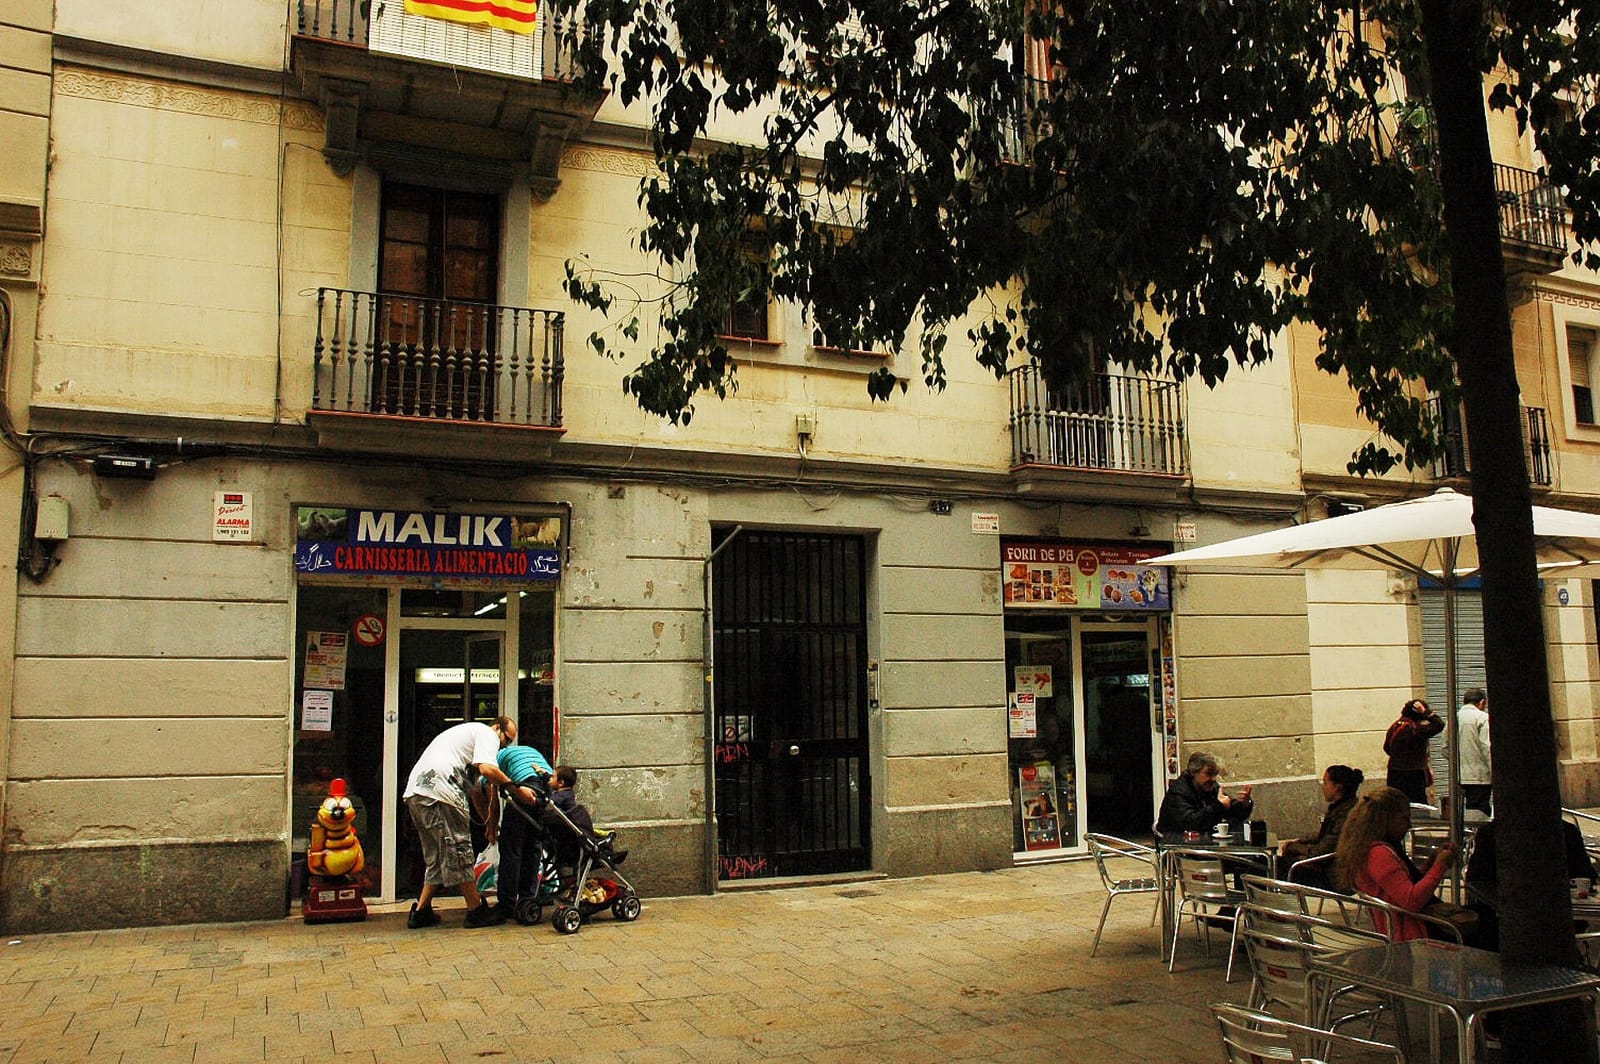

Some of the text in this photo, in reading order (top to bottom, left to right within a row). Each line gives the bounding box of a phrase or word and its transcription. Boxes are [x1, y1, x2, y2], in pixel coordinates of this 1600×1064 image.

[216, 518, 249, 526] ALARMA
[357, 511, 505, 547] MALIK
[335, 546, 528, 575] CARNISSERIA ALIMENTACIÓ
[1007, 547, 1037, 561] FORN
[1041, 549, 1055, 561] DE
[1059, 550, 1074, 562] PA
